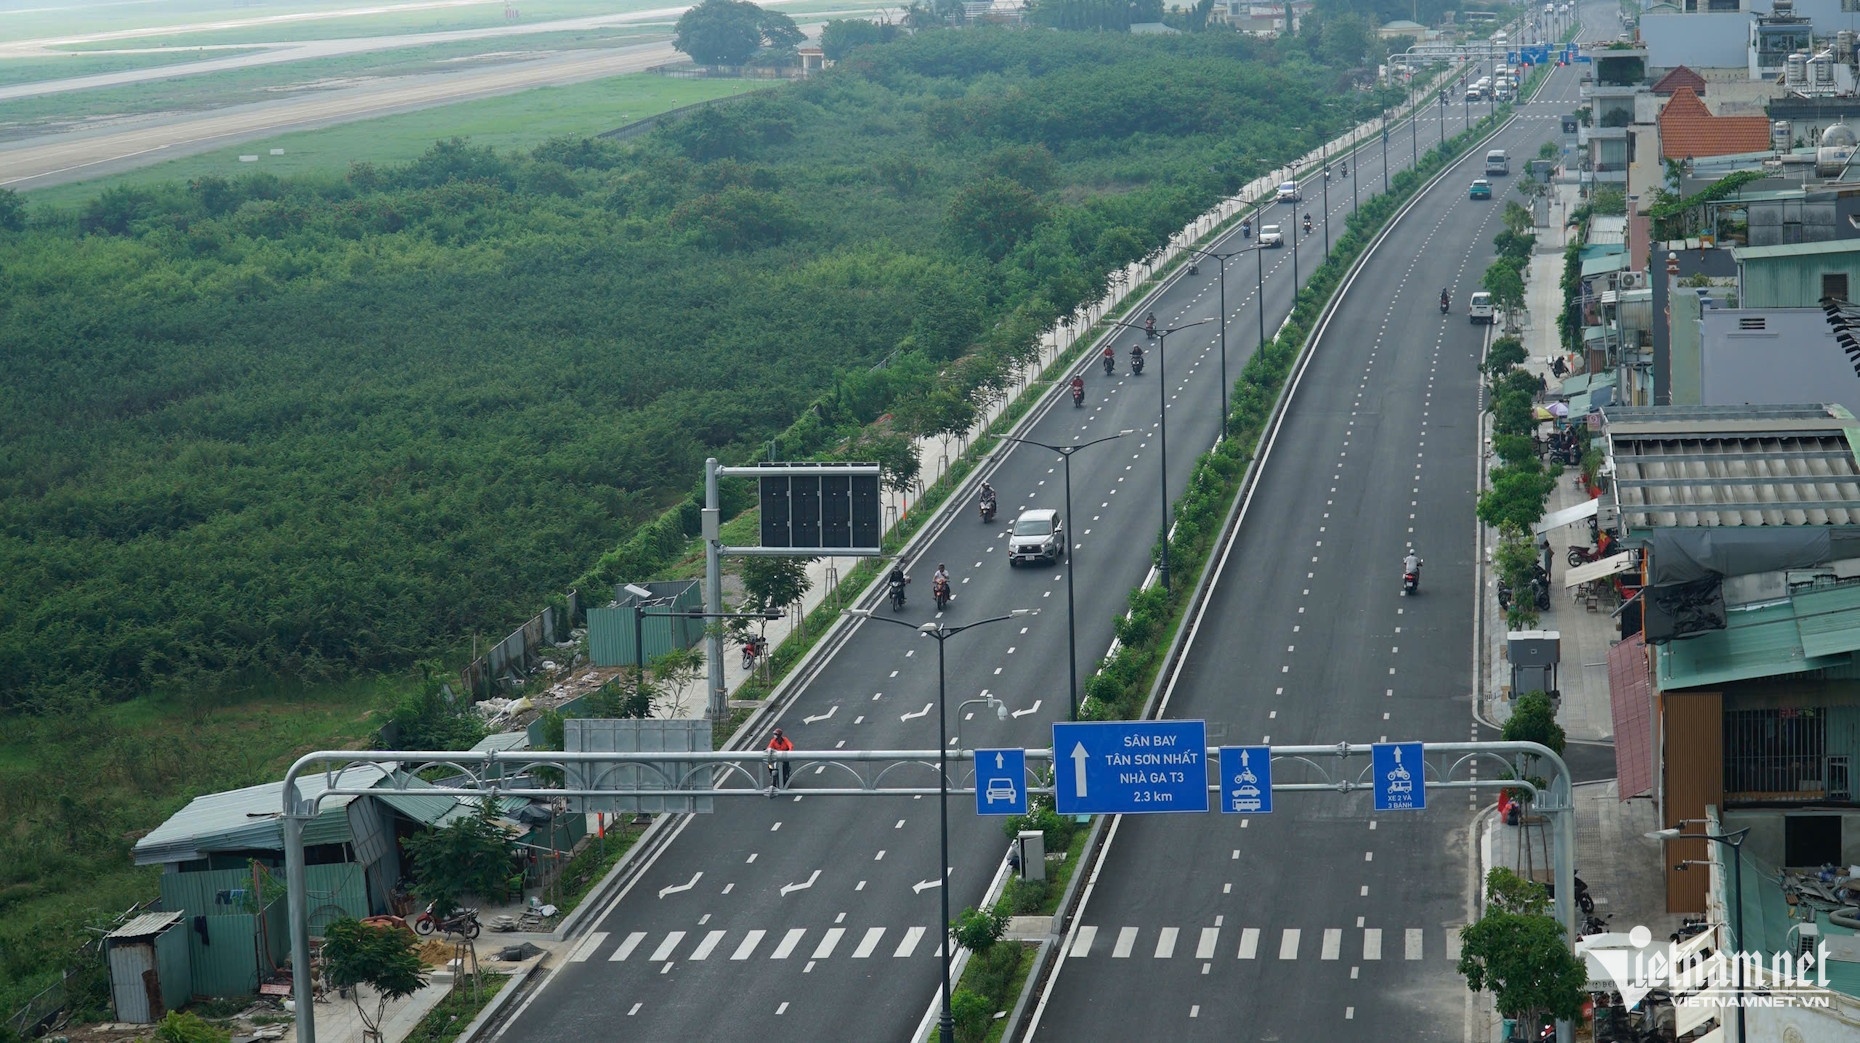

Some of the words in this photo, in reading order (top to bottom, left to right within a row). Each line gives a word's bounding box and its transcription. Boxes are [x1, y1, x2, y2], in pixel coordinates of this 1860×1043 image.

[1124, 734, 1150, 747] SÂN
[1153, 735, 1177, 747] BAY
[1105, 753, 1131, 766] TÂN
[1134, 754, 1161, 765] SƠN
[1163, 749, 1198, 765] NHẤT
[1120, 770, 1147, 784] NHÀ
[1150, 773, 1167, 783] GA
[1169, 772, 1184, 783] T3
[1133, 791, 1151, 802] 2.3
[1154, 791, 1173, 802] km
